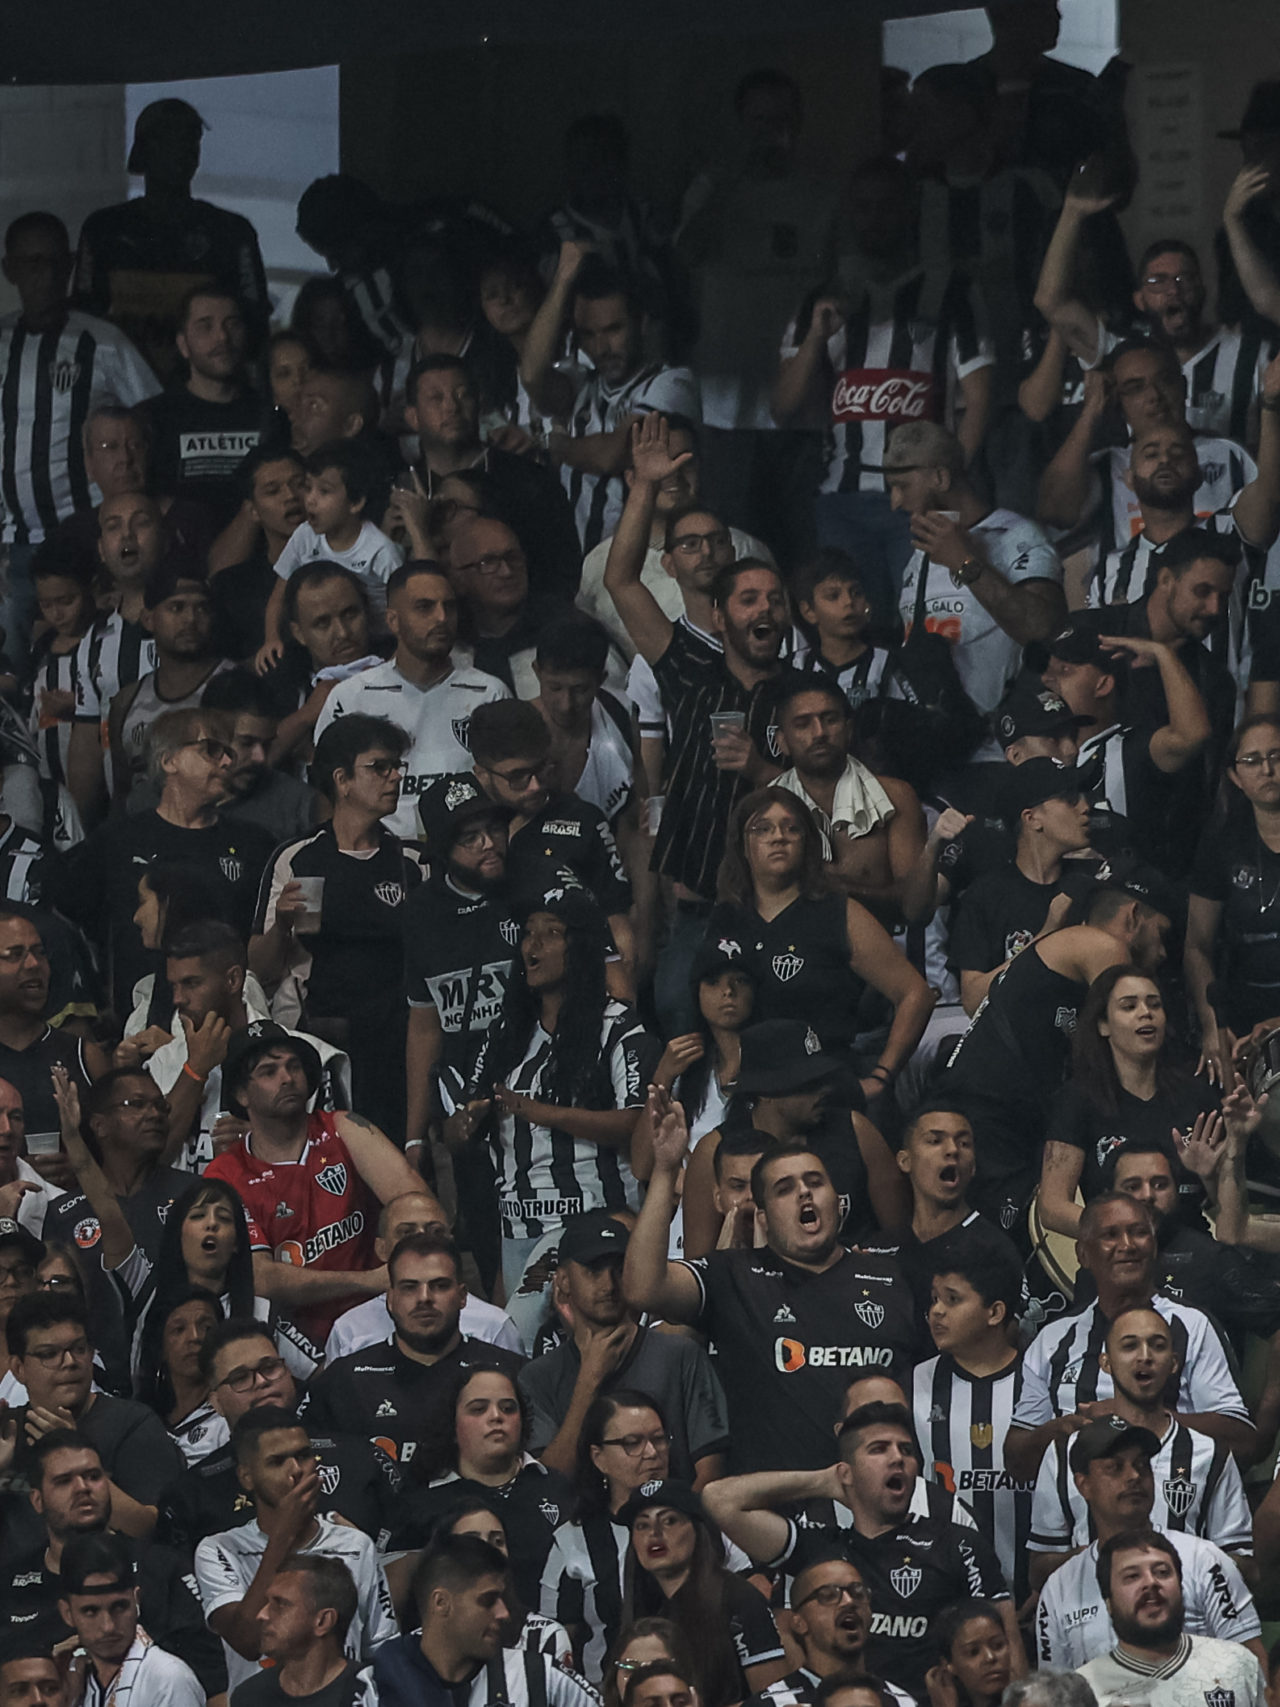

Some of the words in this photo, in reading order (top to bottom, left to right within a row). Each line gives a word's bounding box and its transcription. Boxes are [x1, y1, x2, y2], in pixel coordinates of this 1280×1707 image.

[832, 376, 931, 418] Coca-Cola
[932, 601, 964, 613] GALO
[541, 824, 582, 838] BRASIL
[596, 819, 629, 883] MRV
[627, 1061, 640, 1099] MRV
[525, 1199, 580, 1218] TRUCK
[304, 1213, 364, 1263] BETANO
[285, 1325, 326, 1361] MRV
[808, 1346, 893, 1368] BETANO
[1168, 1483, 1193, 1493] CAM
[963, 1555, 985, 1598] MRV
[1208, 1563, 1238, 1619] MRV
[379, 1579, 396, 1621] MRV
[1066, 1605, 1099, 1625] LUPO
[869, 1612, 929, 1638] TANO
